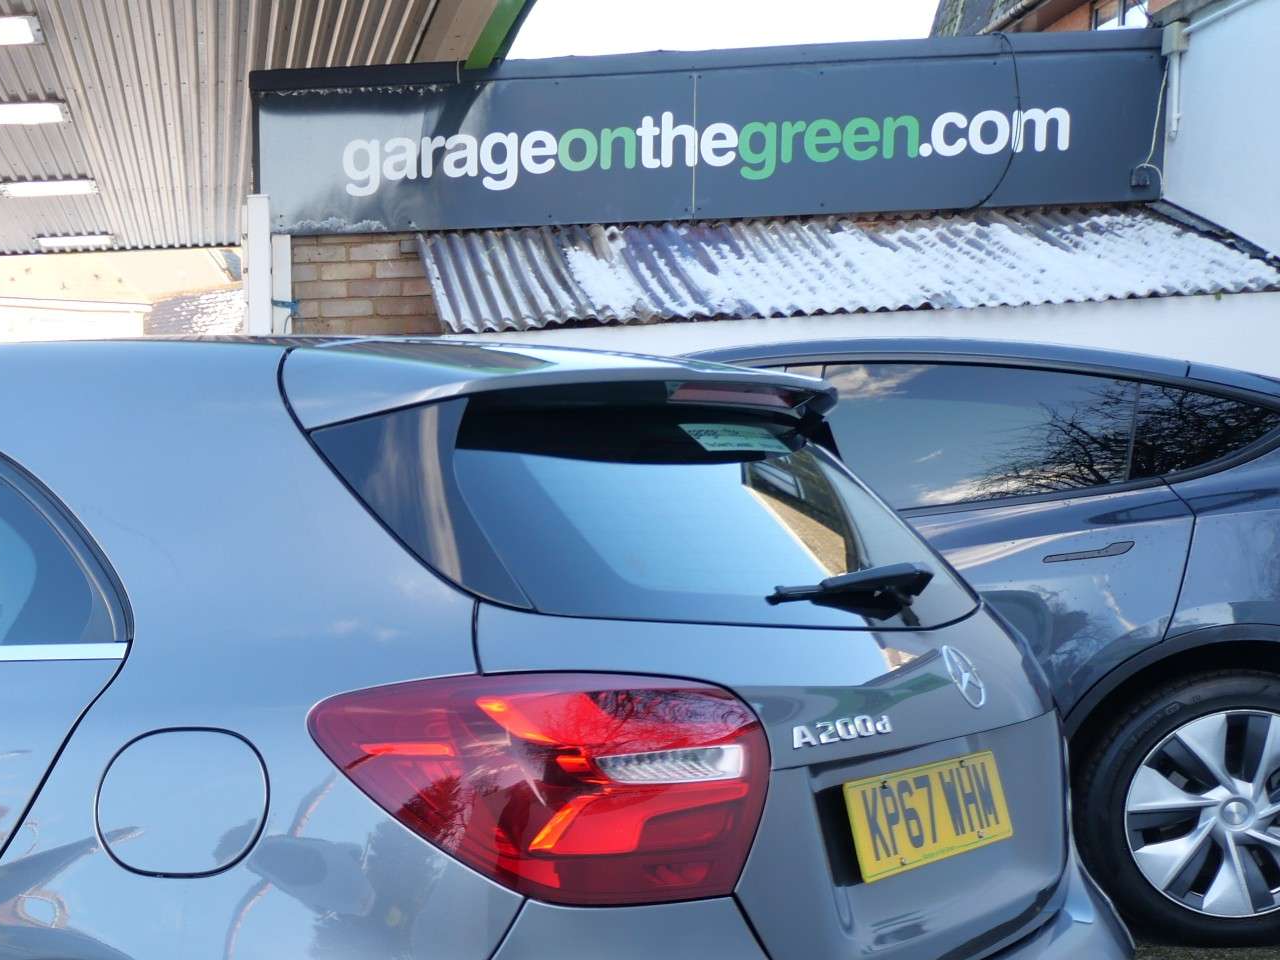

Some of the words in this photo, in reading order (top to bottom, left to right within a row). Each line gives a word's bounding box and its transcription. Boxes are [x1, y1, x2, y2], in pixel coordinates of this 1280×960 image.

[342, 106, 1071, 197] garageonthegreen.com
[792, 714, 892, 749] A200d
[860, 774, 938, 861] KP67
[938, 762, 1000, 837] WHM
